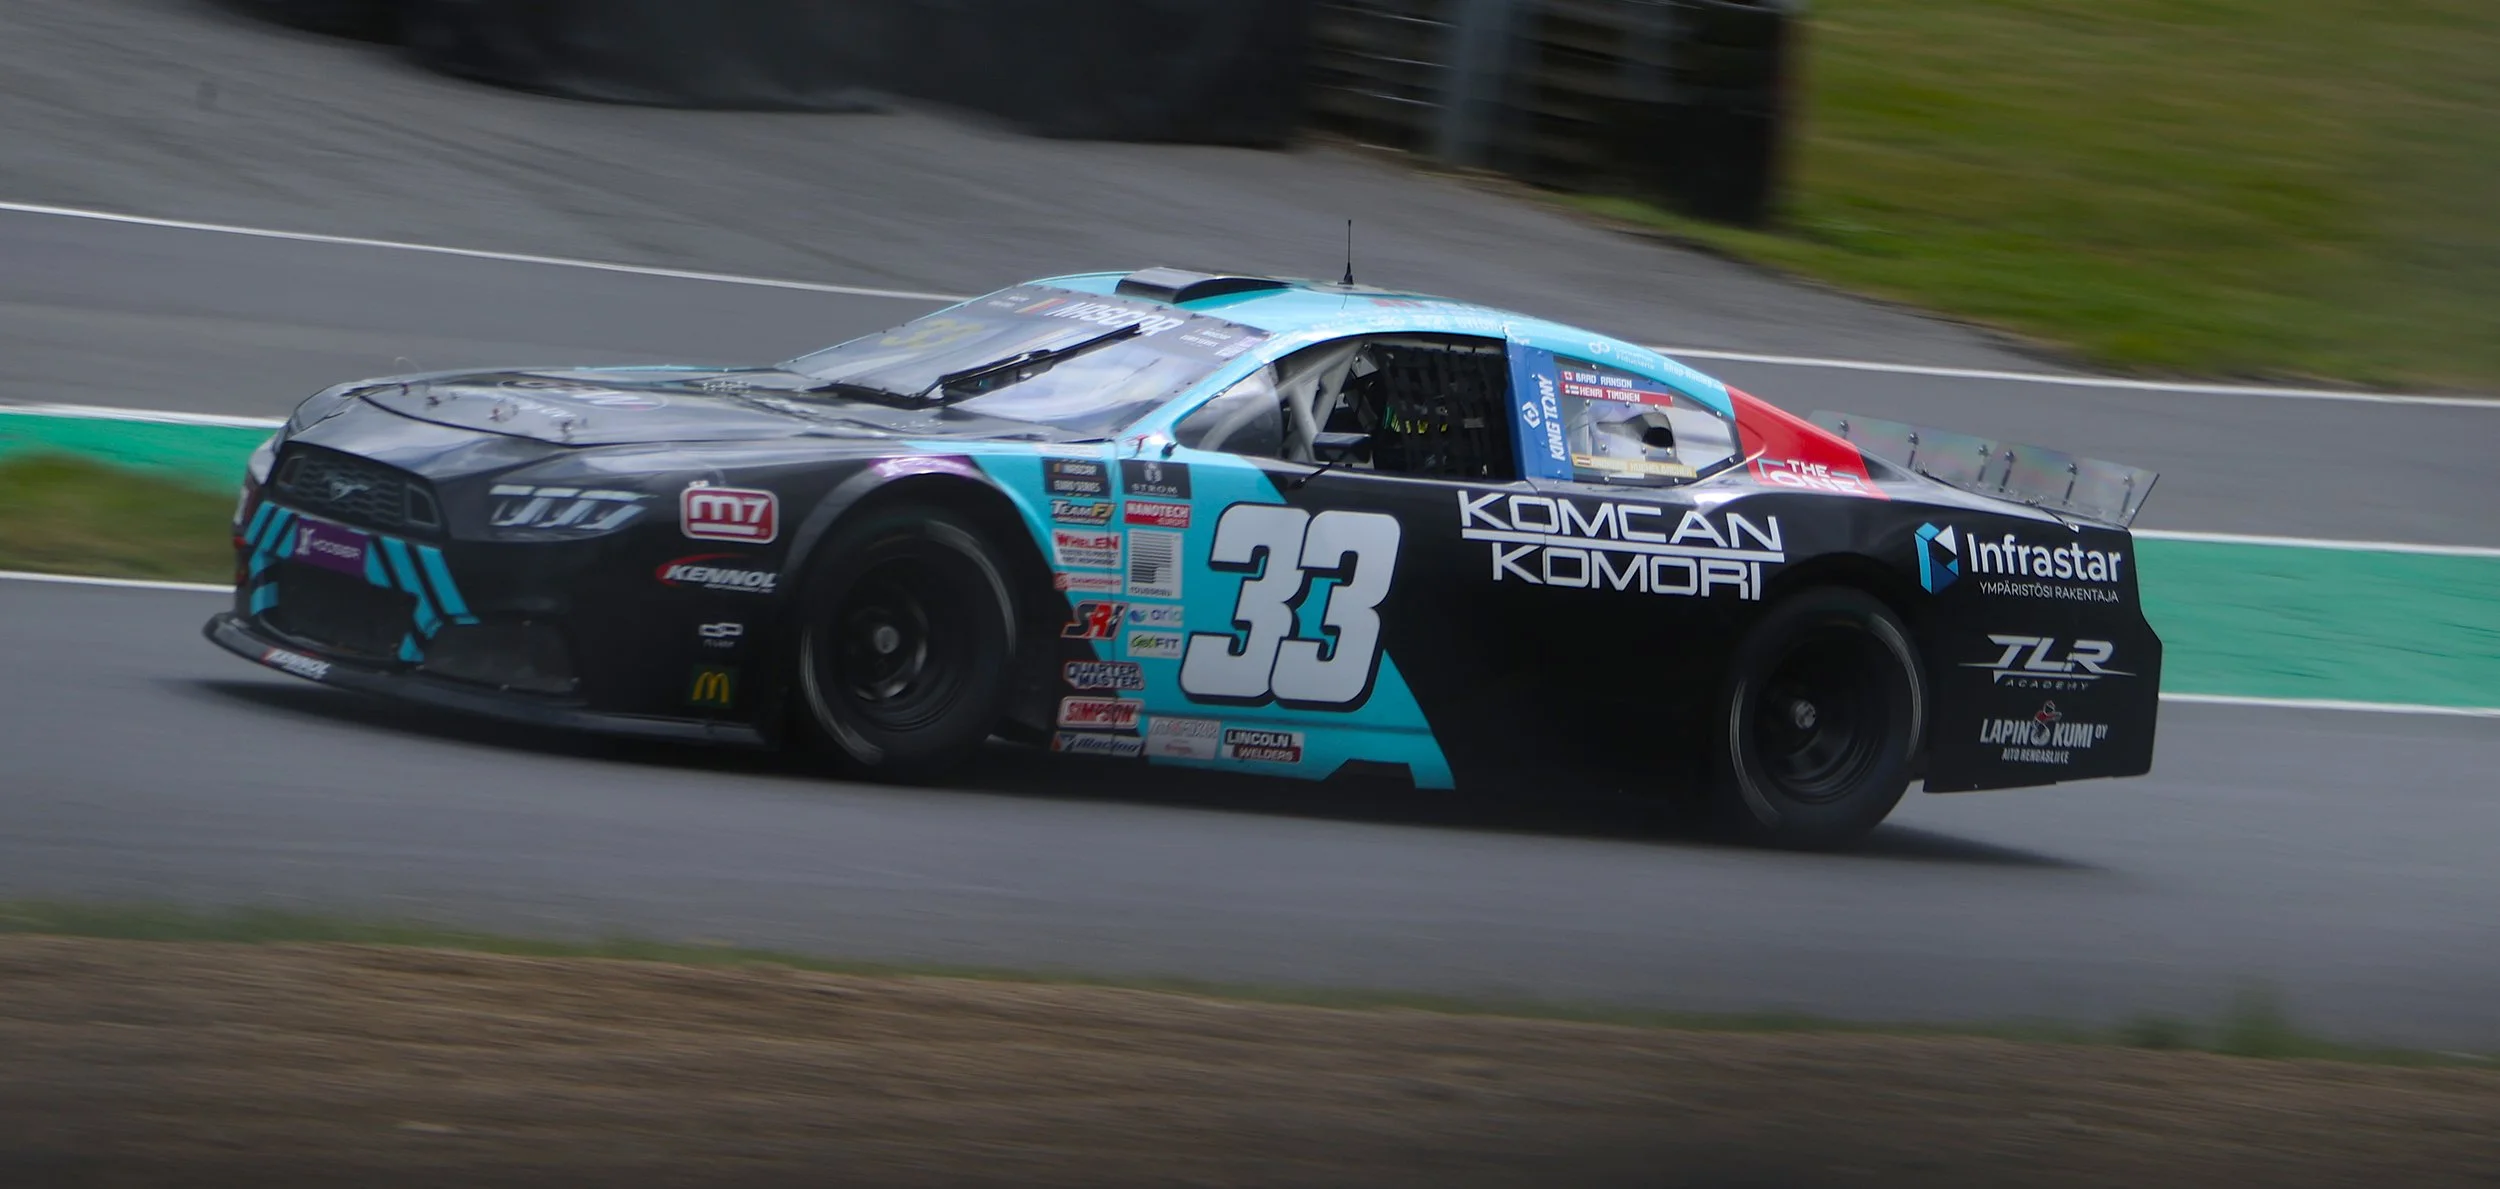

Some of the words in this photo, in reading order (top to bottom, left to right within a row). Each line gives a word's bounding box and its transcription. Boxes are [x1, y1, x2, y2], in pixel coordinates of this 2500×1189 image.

[1044, 302, 1184, 336] NASCAR
[1576, 372, 1597, 384] BRAD
[1600, 376, 1632, 389] RANSON
[1580, 385, 1603, 398] HENRI
[1606, 389, 1641, 403] TIMONEN
[1537, 374, 1558, 420] TONY
[1546, 421, 1566, 461] KING
[1786, 459, 1830, 478] THE
[1770, 470, 1868, 496] ONE
[1457, 490, 1784, 551] KOMCAN
[1492, 542, 1761, 600] KOMORI
[1967, 533, 2122, 582] Infrastar
[663, 564, 777, 588] KENNOL
[1180, 502, 1401, 708] 33
[1979, 580, 2052, 598] YMPÄRISTÖSI
[2055, 588, 2120, 603] RAKENTAJA
[1985, 633, 2115, 675] TLR
[2005, 679, 2089, 690] ACADEMY
[1226, 730, 1290, 747] LINCOLN
[1980, 718, 2032, 745] LAPIN
[2052, 722, 2094, 748] KUMI
[1239, 747, 1294, 761] WELDERS
